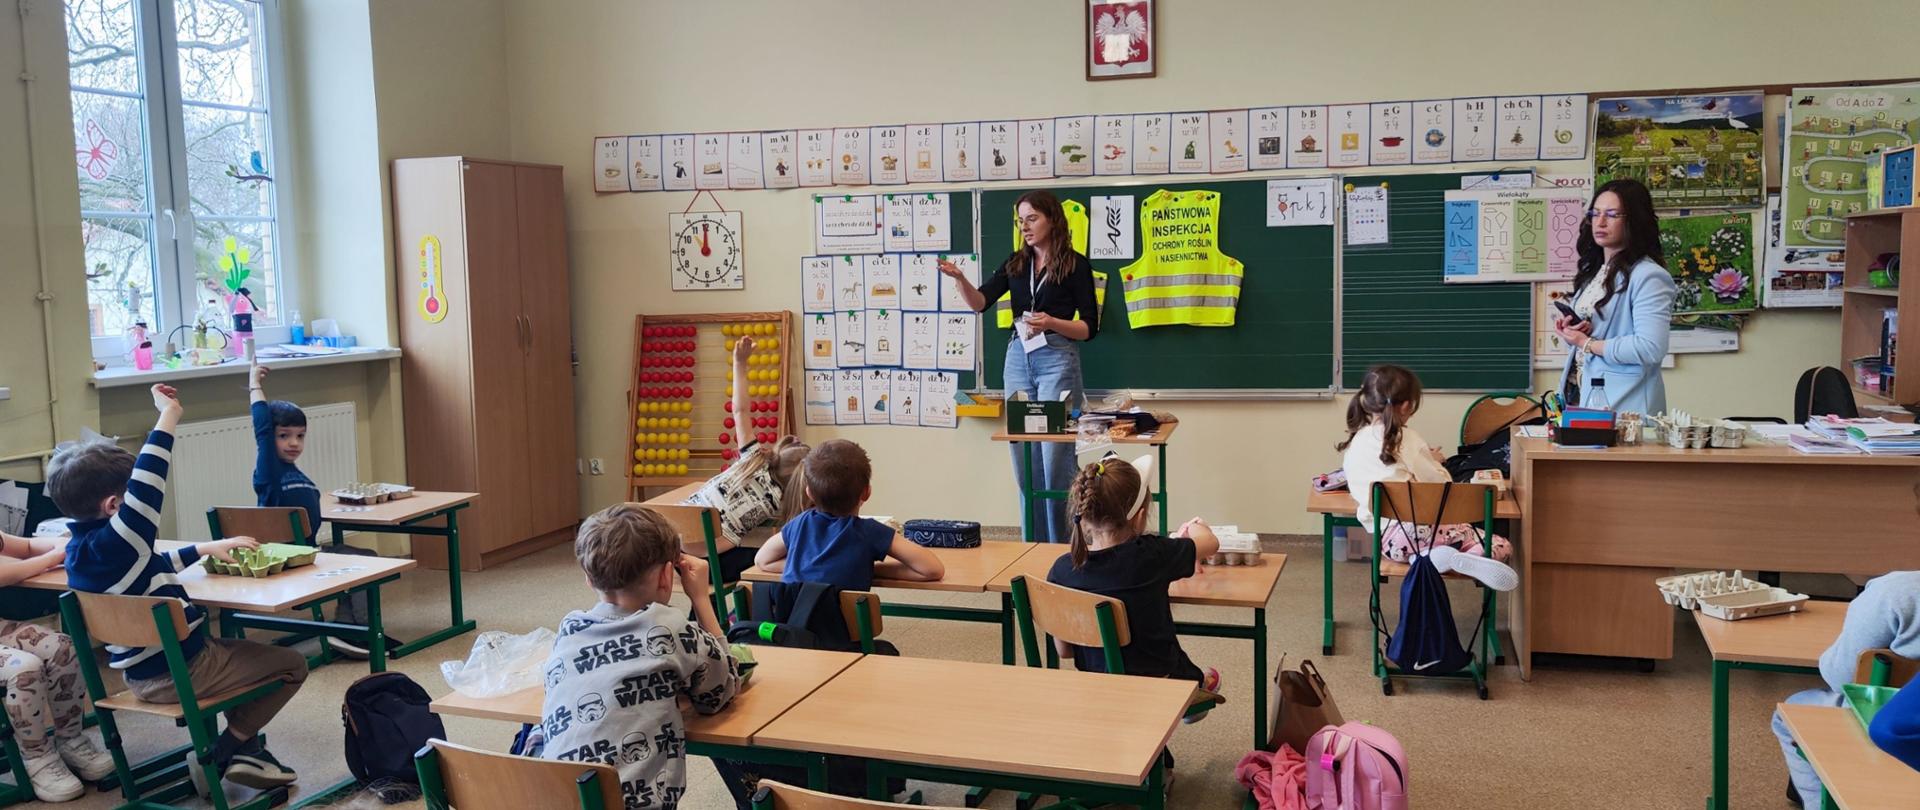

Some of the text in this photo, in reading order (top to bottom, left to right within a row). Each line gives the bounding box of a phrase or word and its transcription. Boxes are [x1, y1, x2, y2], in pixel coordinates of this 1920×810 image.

[1862, 98, 1875, 106] do
[1877, 98, 1884, 106] Z
[902, 198, 912, 206] Ni
[1306, 192, 1315, 211] k
[1152, 206, 1211, 222] PAŃSTWOWA
[702, 223, 709, 232] 12
[716, 226, 719, 234] 1
[1152, 223, 1211, 238] INSPEKCJA
[684, 235, 692, 244] 10
[723, 234, 728, 243] 2
[1152, 237, 1212, 251] OCHRONY ROŚLIN
[681, 248, 686, 256] 9
[728, 247, 733, 255] 3
[1093, 248, 1123, 256] PIORIN
[881, 258, 891, 266] Ci
[1160, 252, 1208, 264] NASIENNICTWA
[685, 260, 690, 268] 8
[723, 259, 728, 267] 4
[820, 260, 829, 268] Si
[694, 267, 698, 275] 7
[705, 270, 709, 279] 6
[716, 266, 721, 275] 5
[573, 634, 642, 663] STAR
[574, 643, 643, 675] WARS
[613, 669, 680, 695] STAR
